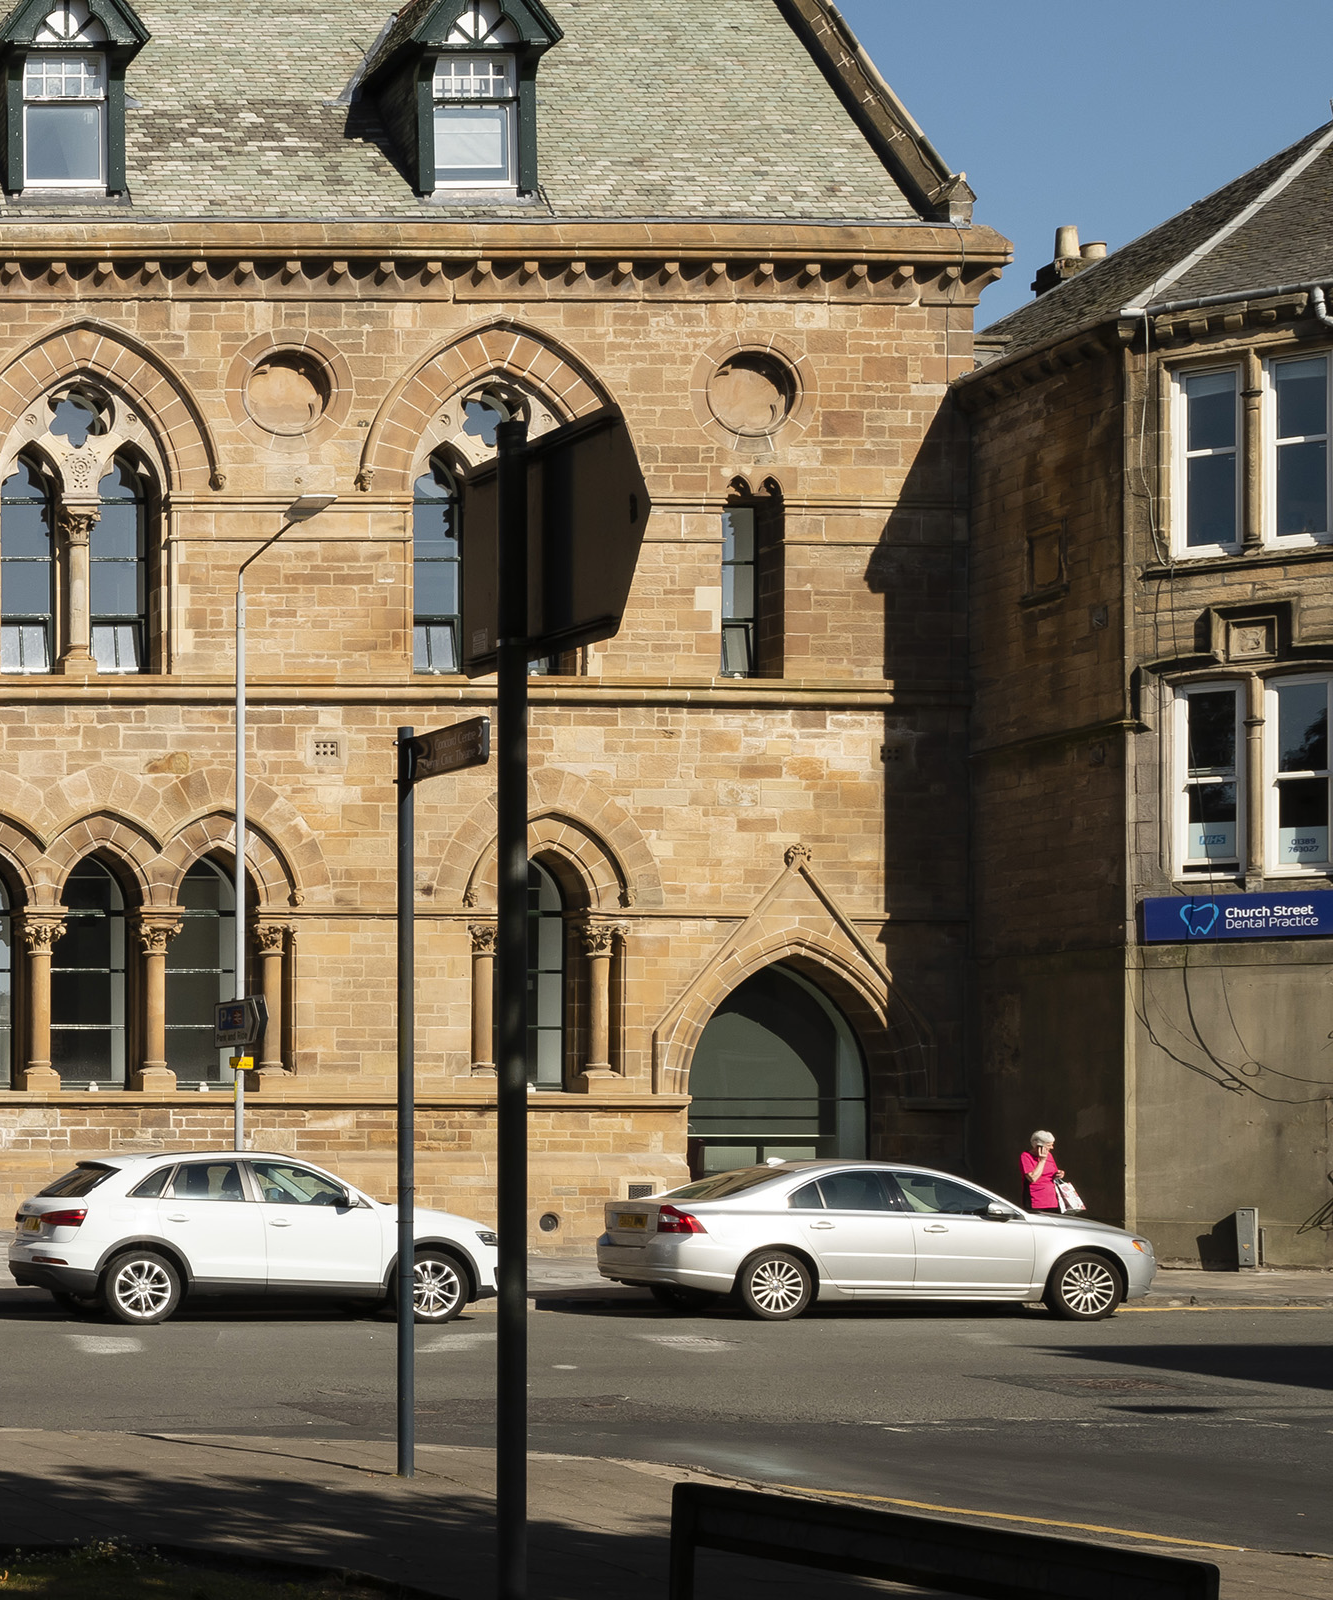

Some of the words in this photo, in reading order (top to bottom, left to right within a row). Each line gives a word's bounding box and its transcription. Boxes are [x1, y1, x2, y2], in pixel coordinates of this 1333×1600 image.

[1200, 835, 1226, 845] NHS
[1225, 906, 1270, 918] Church
[1273, 905, 1314, 916] Street
[1225, 918, 1266, 929] Dental
[1269, 916, 1319, 928] Practice
